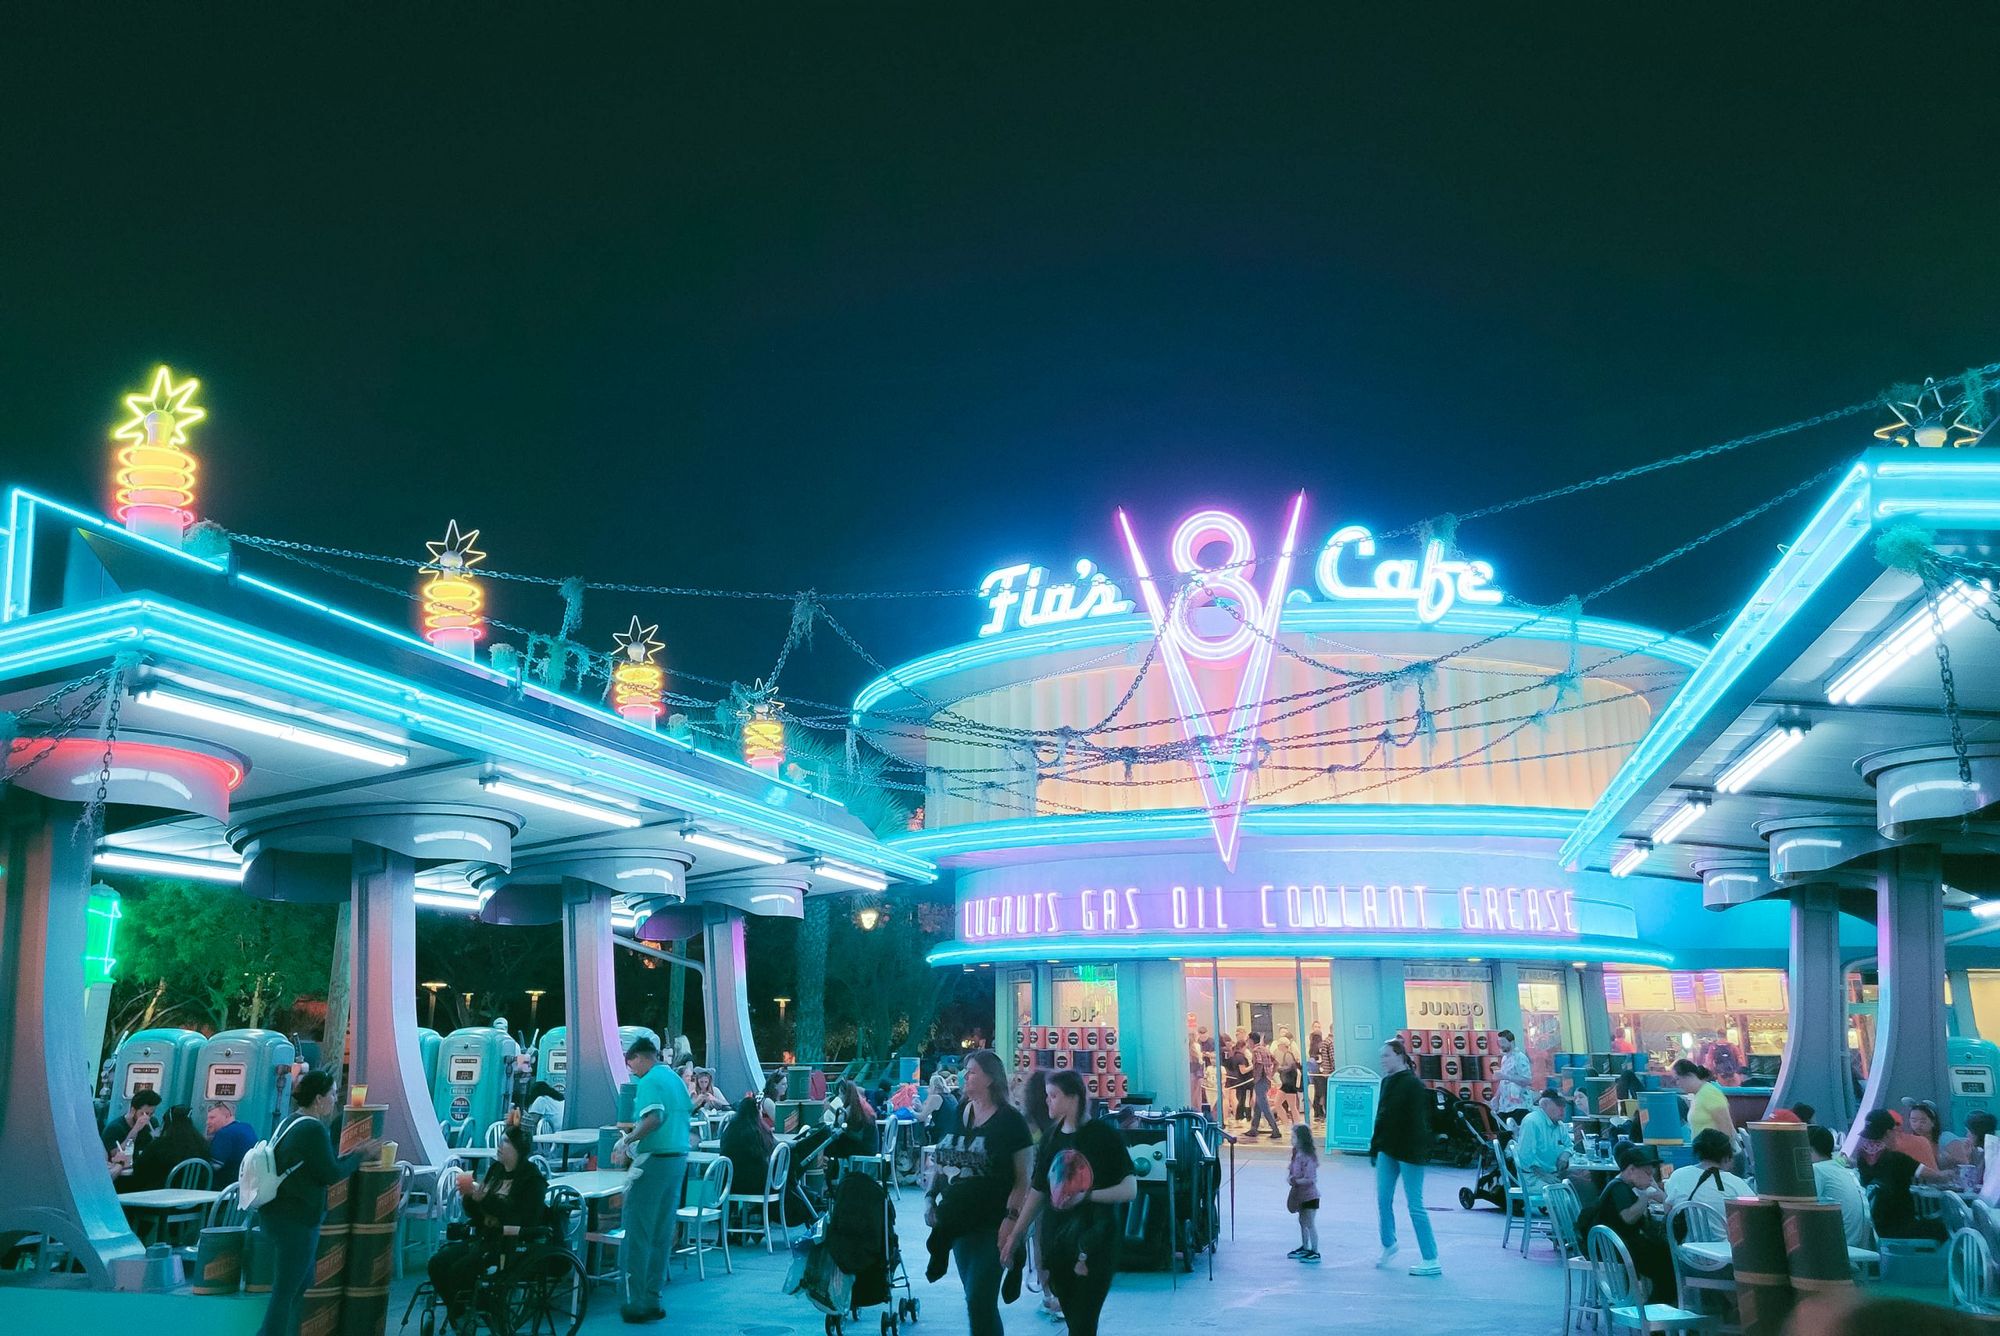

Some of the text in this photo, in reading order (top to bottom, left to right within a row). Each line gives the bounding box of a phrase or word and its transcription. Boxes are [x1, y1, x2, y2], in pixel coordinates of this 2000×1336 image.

[1315, 525, 1503, 623] Cafe
[963, 885, 1578, 938] LUGNUTS GAS OIL COOLANT GREASE
[1418, 1001, 1484, 1017] JUMBO
